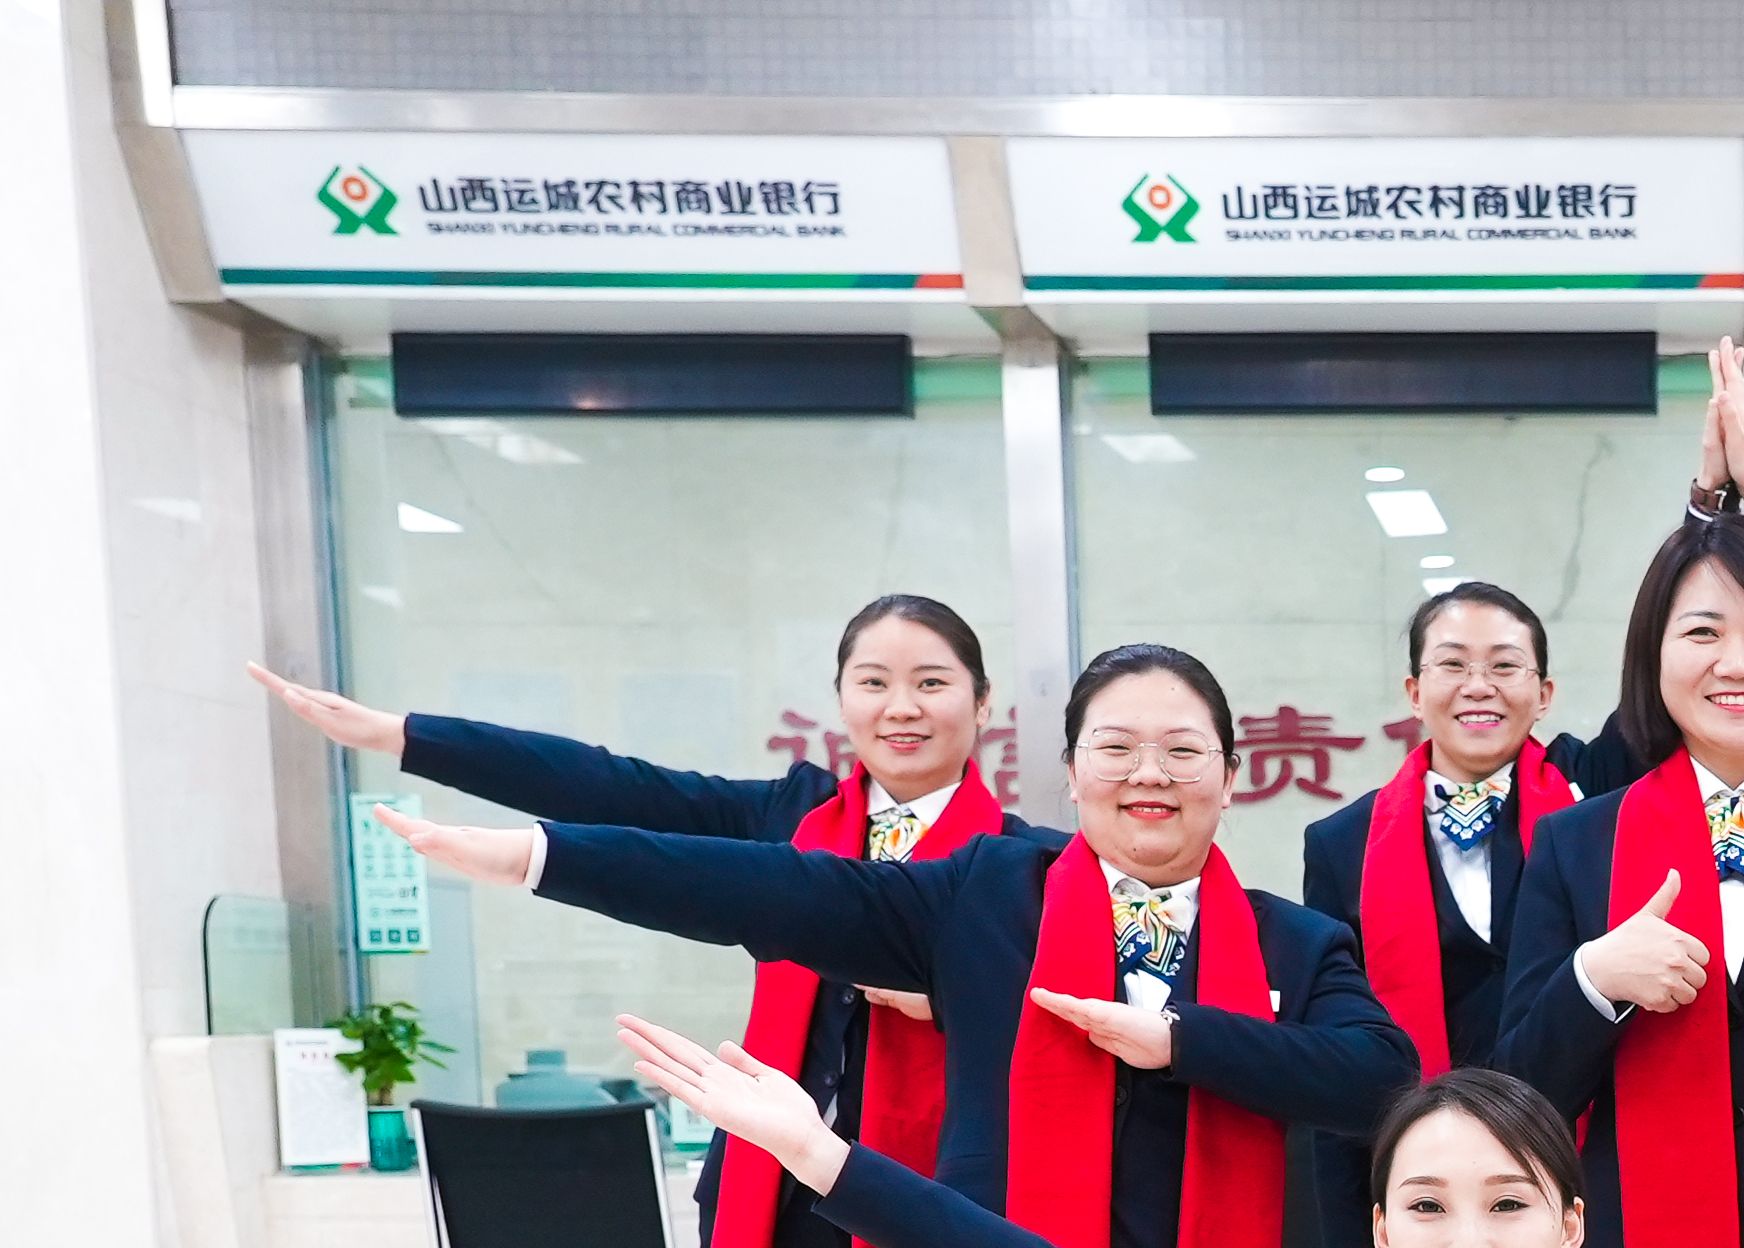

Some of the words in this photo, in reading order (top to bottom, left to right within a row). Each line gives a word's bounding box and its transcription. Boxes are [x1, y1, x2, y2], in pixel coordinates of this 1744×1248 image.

[418, 178, 840, 215] 山西运城农村商业银行
[1222, 185, 1637, 219] 山西运城农村商业银行
[1401, 229, 1461, 241] RURAL
[1590, 229, 1637, 240] BANK
